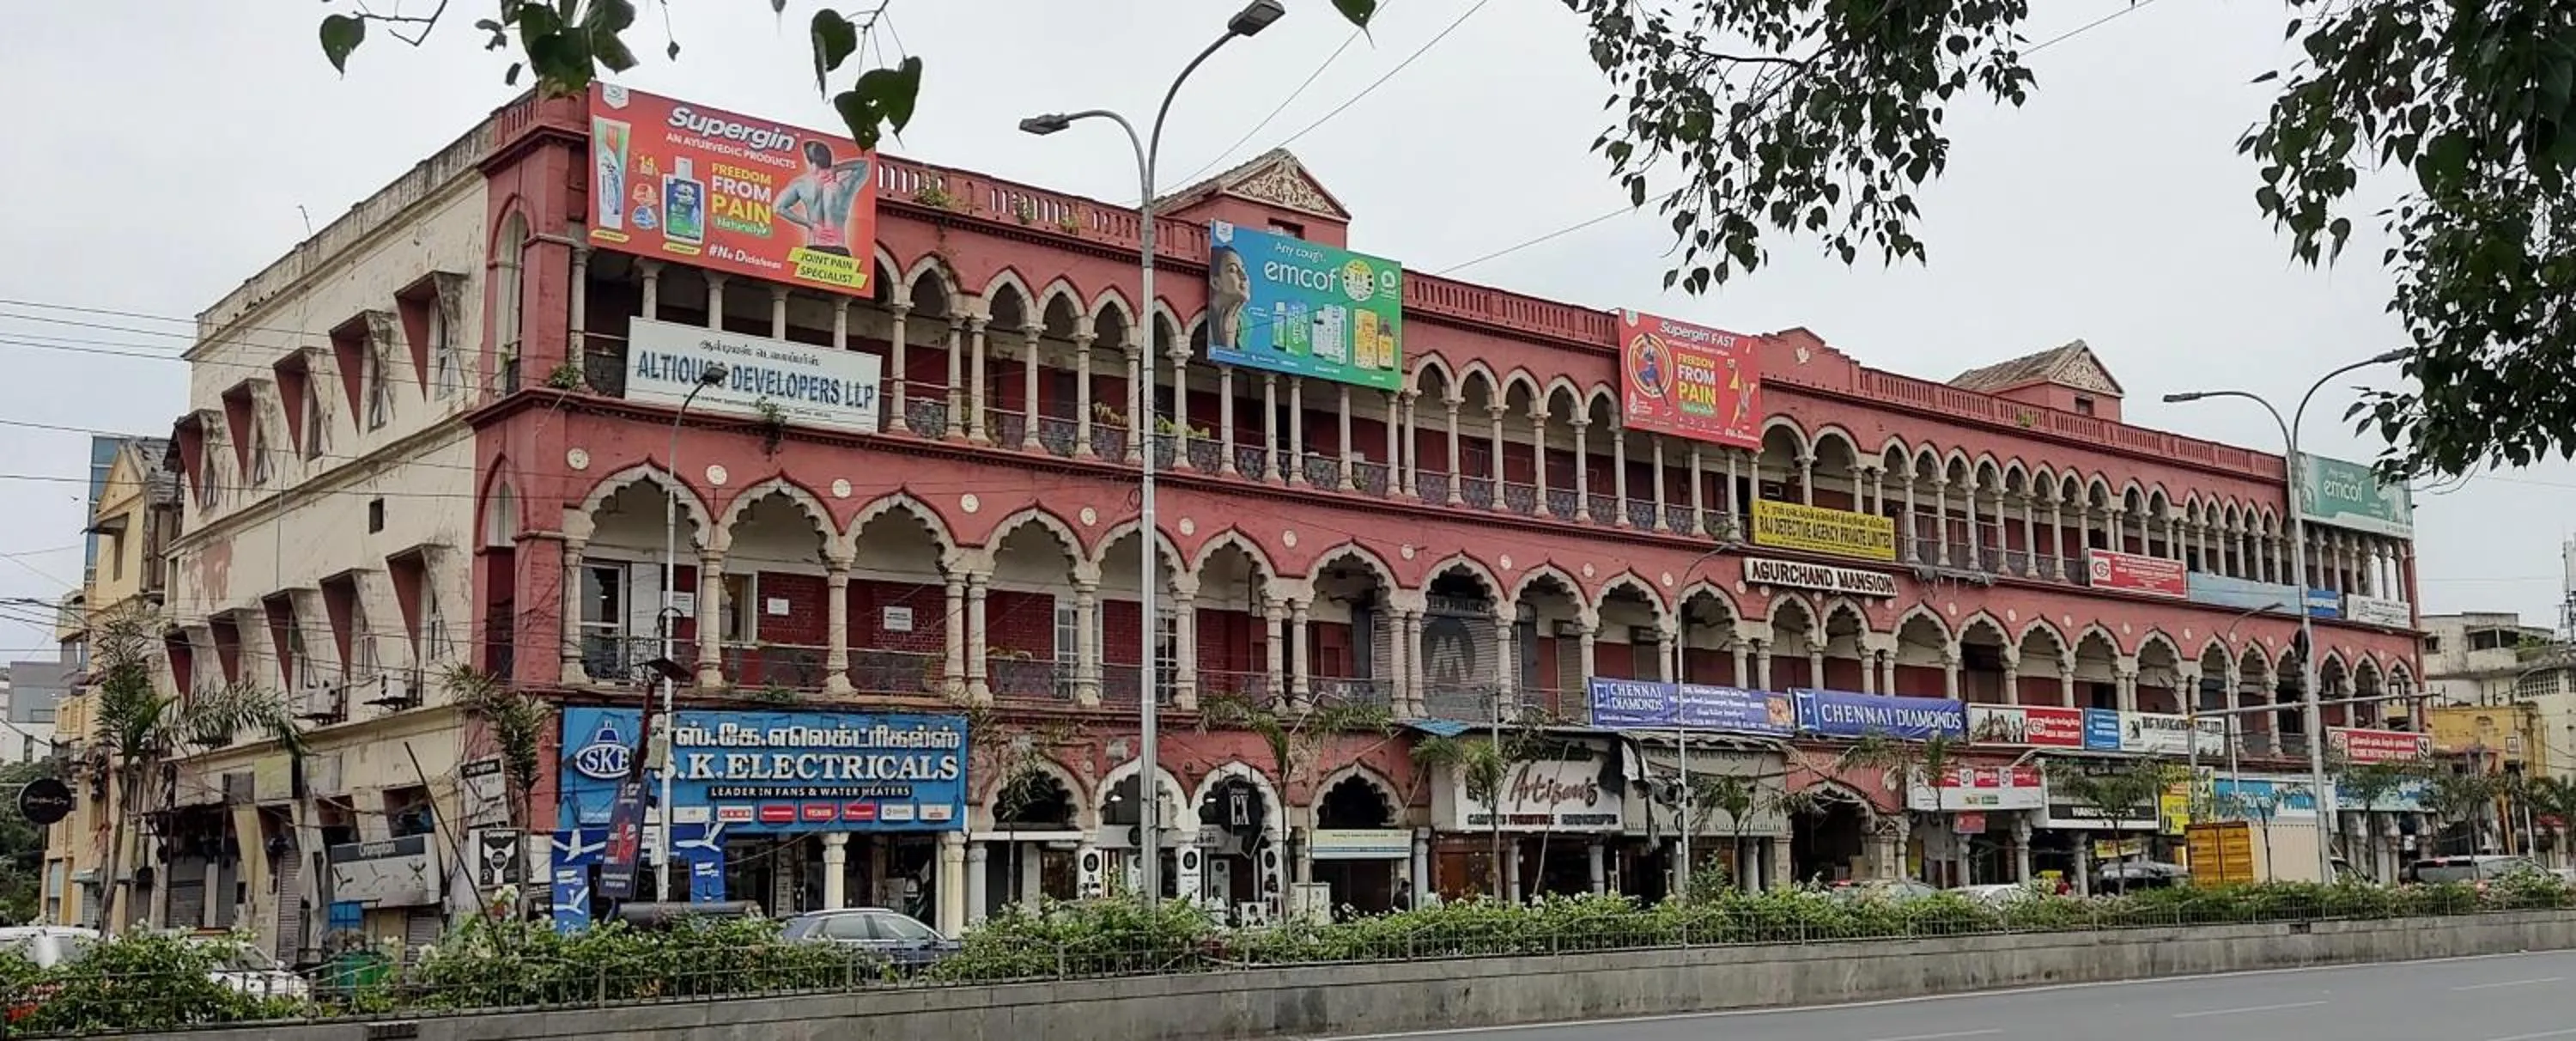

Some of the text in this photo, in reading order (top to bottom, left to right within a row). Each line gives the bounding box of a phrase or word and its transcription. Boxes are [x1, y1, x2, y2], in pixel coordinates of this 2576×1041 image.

[668, 107, 797, 152] Supergin
[666, 132, 797, 169] AN AYURVEDIC PRODUCTS
[712, 162, 772, 185] FREEDOM
[712, 176, 771, 202] FROM
[712, 193, 772, 225] PAIN
[800, 252, 853, 270] JOINT PAIN
[799, 265, 853, 284] SPECIALIST
[1264, 260, 1337, 293] emcof
[1710, 332, 1735, 348] FAST
[636, 350, 726, 387] ALTIOU
[732, 364, 841, 405] DEVELOPERS
[845, 381, 874, 410] LLP
[1677, 364, 1716, 385] FROM
[1678, 380, 1716, 406] PAIN
[2323, 481, 2363, 502] emcof
[1753, 561, 1896, 594] AGURCHAND MANSION
[1610, 684, 1662, 698] CHENNAI
[1611, 697, 1664, 711] DIAMONDS
[1821, 703, 1962, 730] CHENNAI DIAMONDS
[711, 787, 910, 797] LEADER IN FANS & WATER HEATERS
